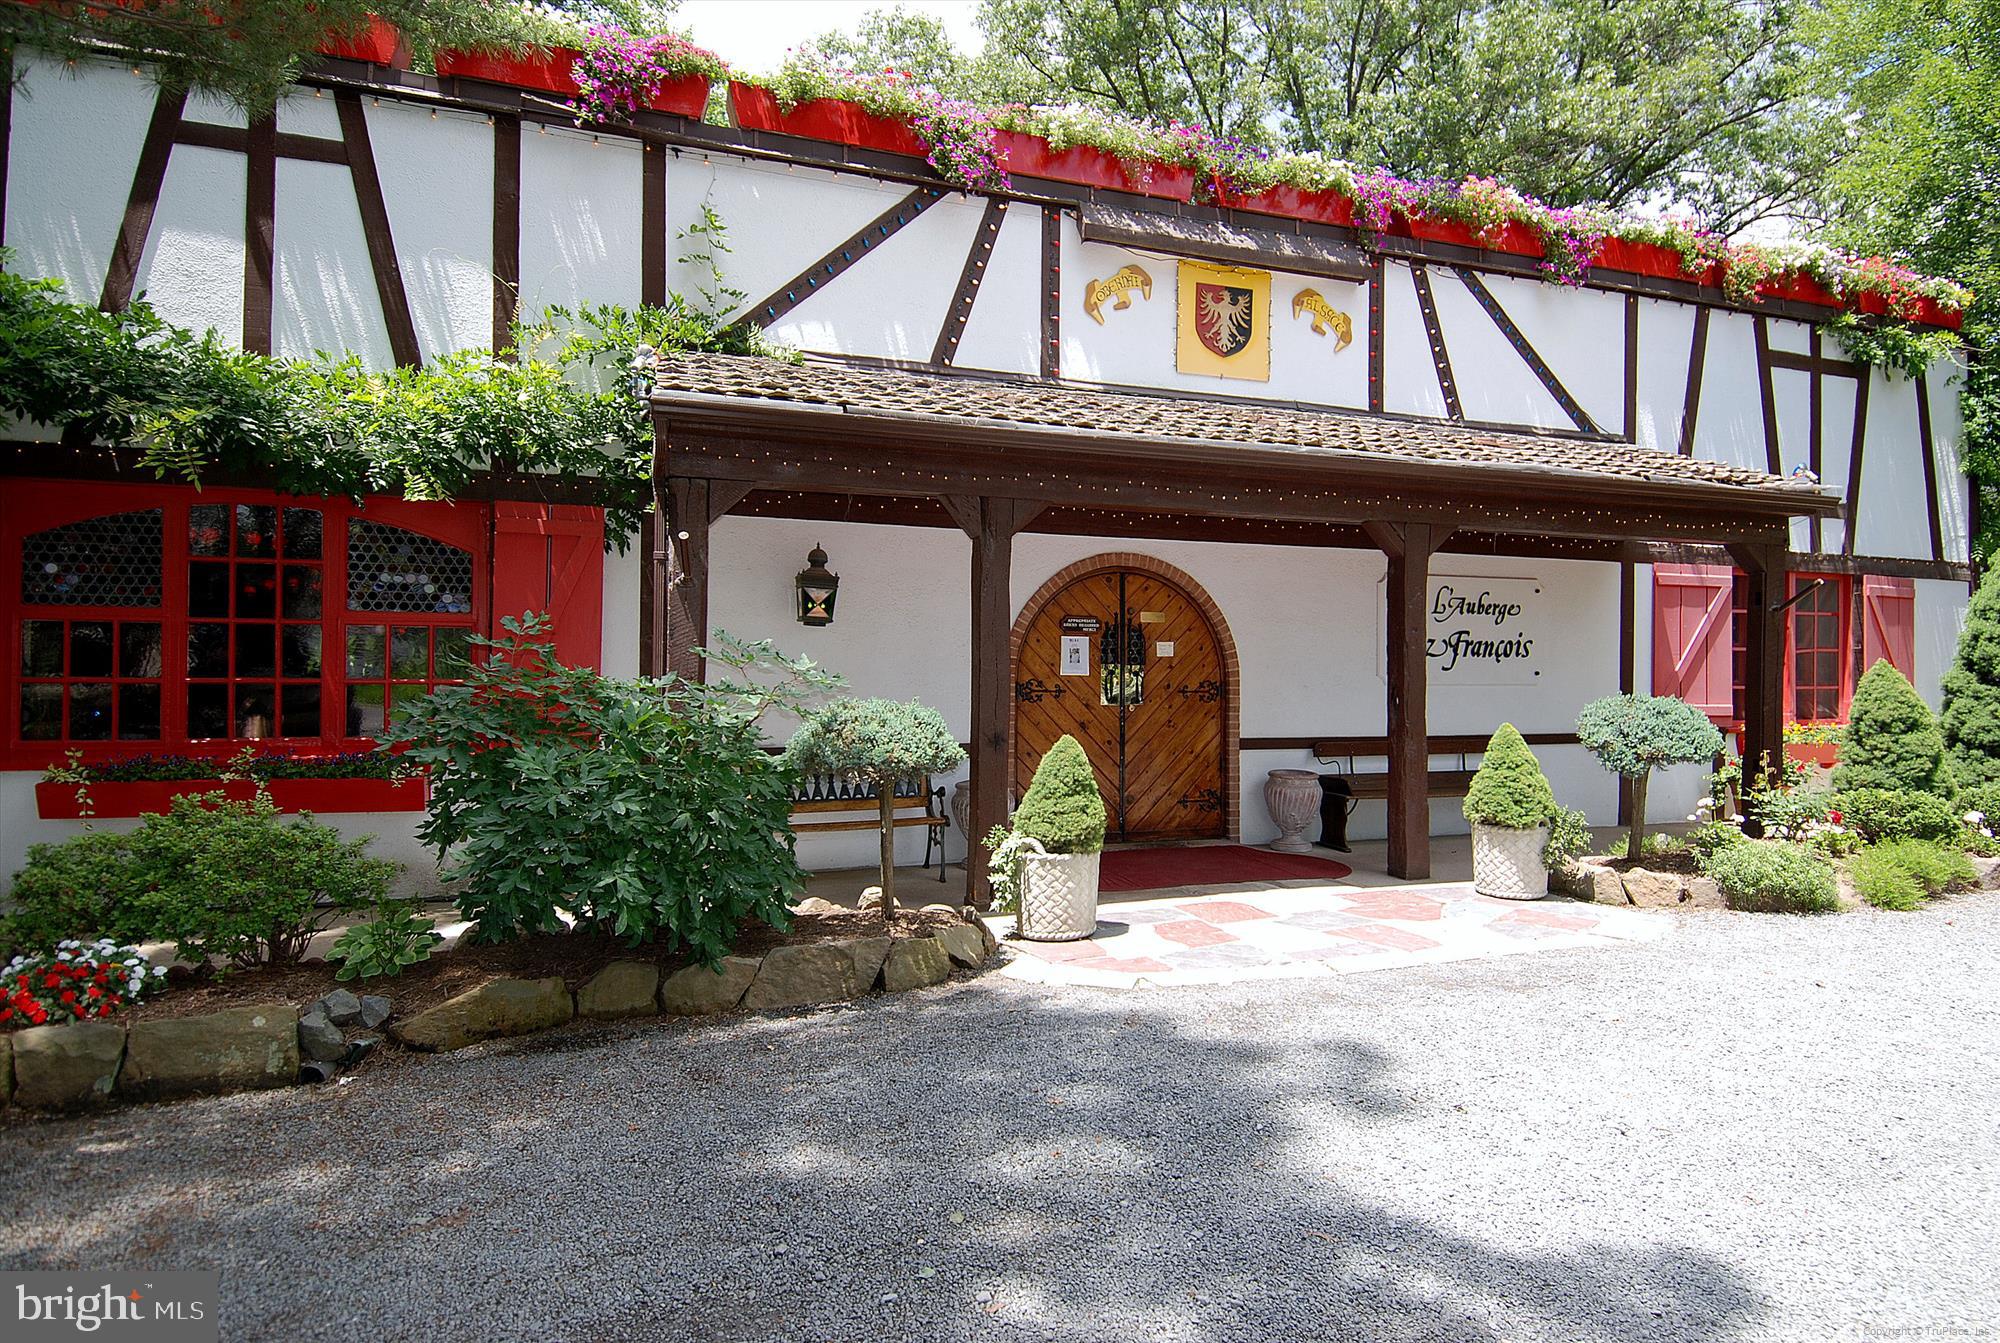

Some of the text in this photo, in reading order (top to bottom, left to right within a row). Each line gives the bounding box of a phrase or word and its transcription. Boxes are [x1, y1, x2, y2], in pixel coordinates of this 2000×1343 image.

[1304, 298, 1345, 333] ALSACE
[1431, 585, 1521, 626] L'Auberge
[1441, 630, 1534, 672] François
